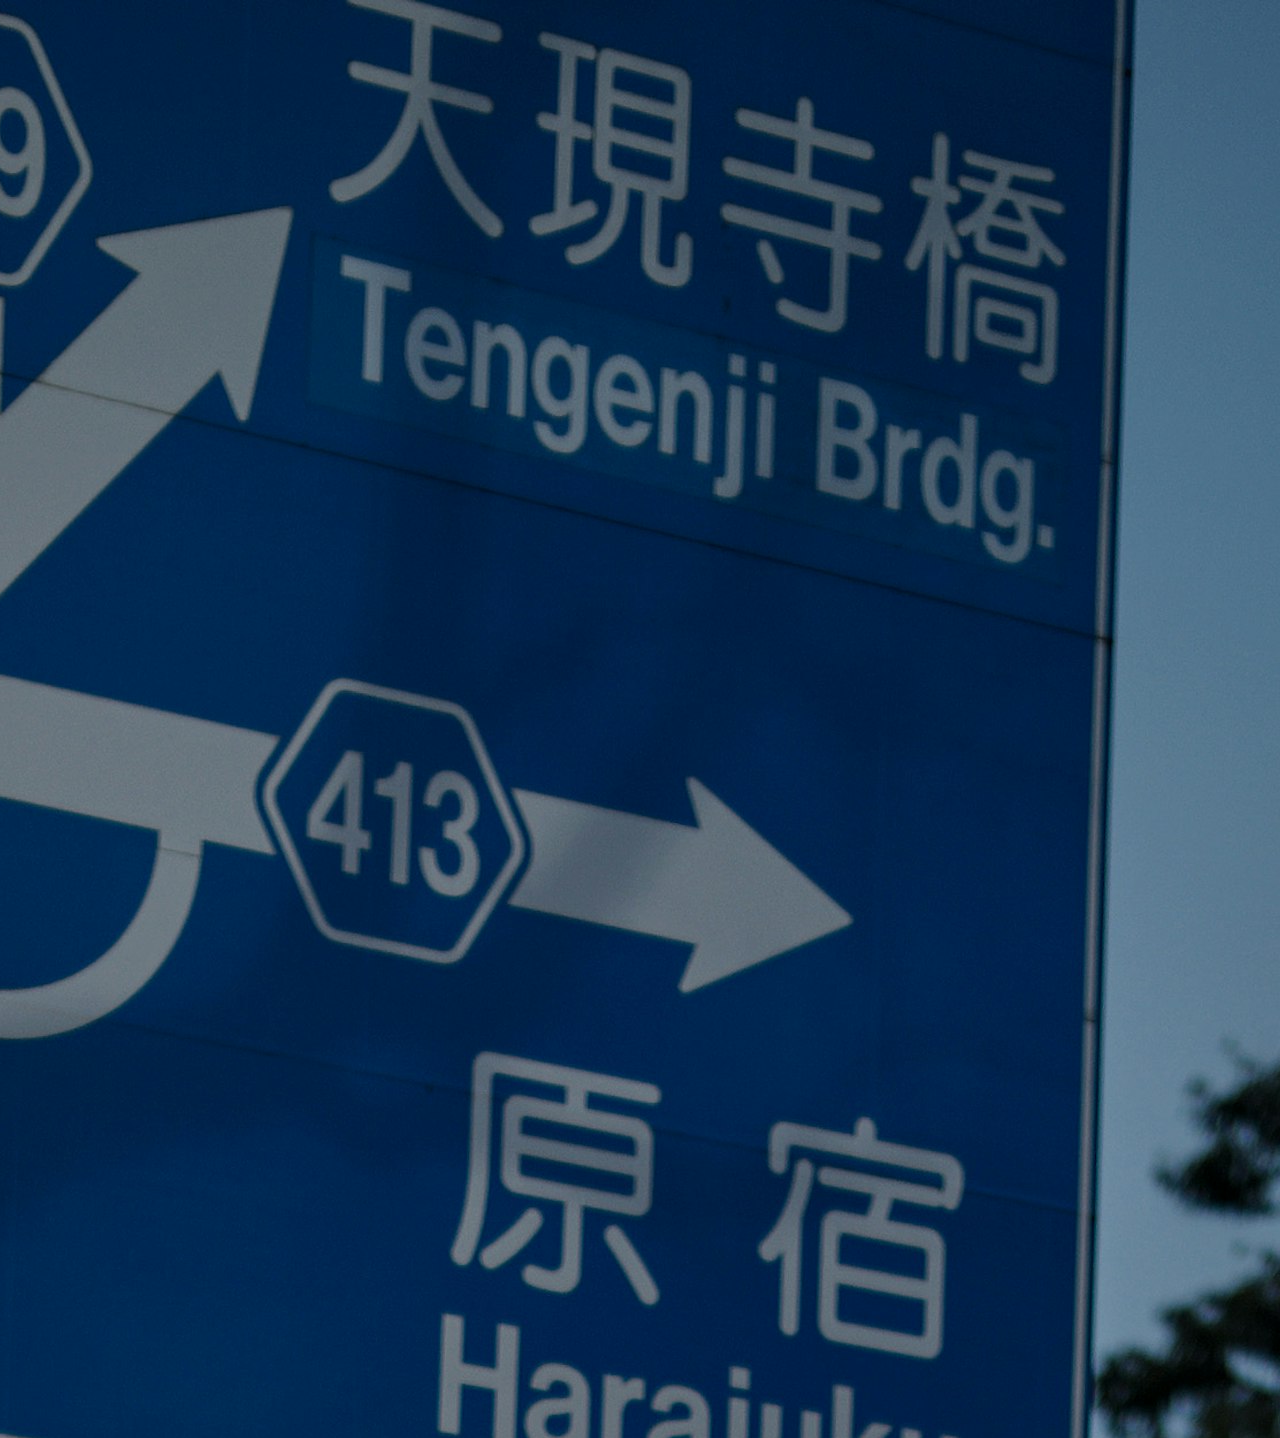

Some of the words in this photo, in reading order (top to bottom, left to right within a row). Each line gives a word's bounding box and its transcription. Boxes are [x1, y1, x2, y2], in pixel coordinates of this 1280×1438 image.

[328, 0, 1066, 385] 天現寺橋
[340, 254, 776, 498] Tengenji
[816, 376, 1055, 564] Brdg.
[305, 749, 482, 898] 413
[449, 1050, 965, 1360] 原宿
